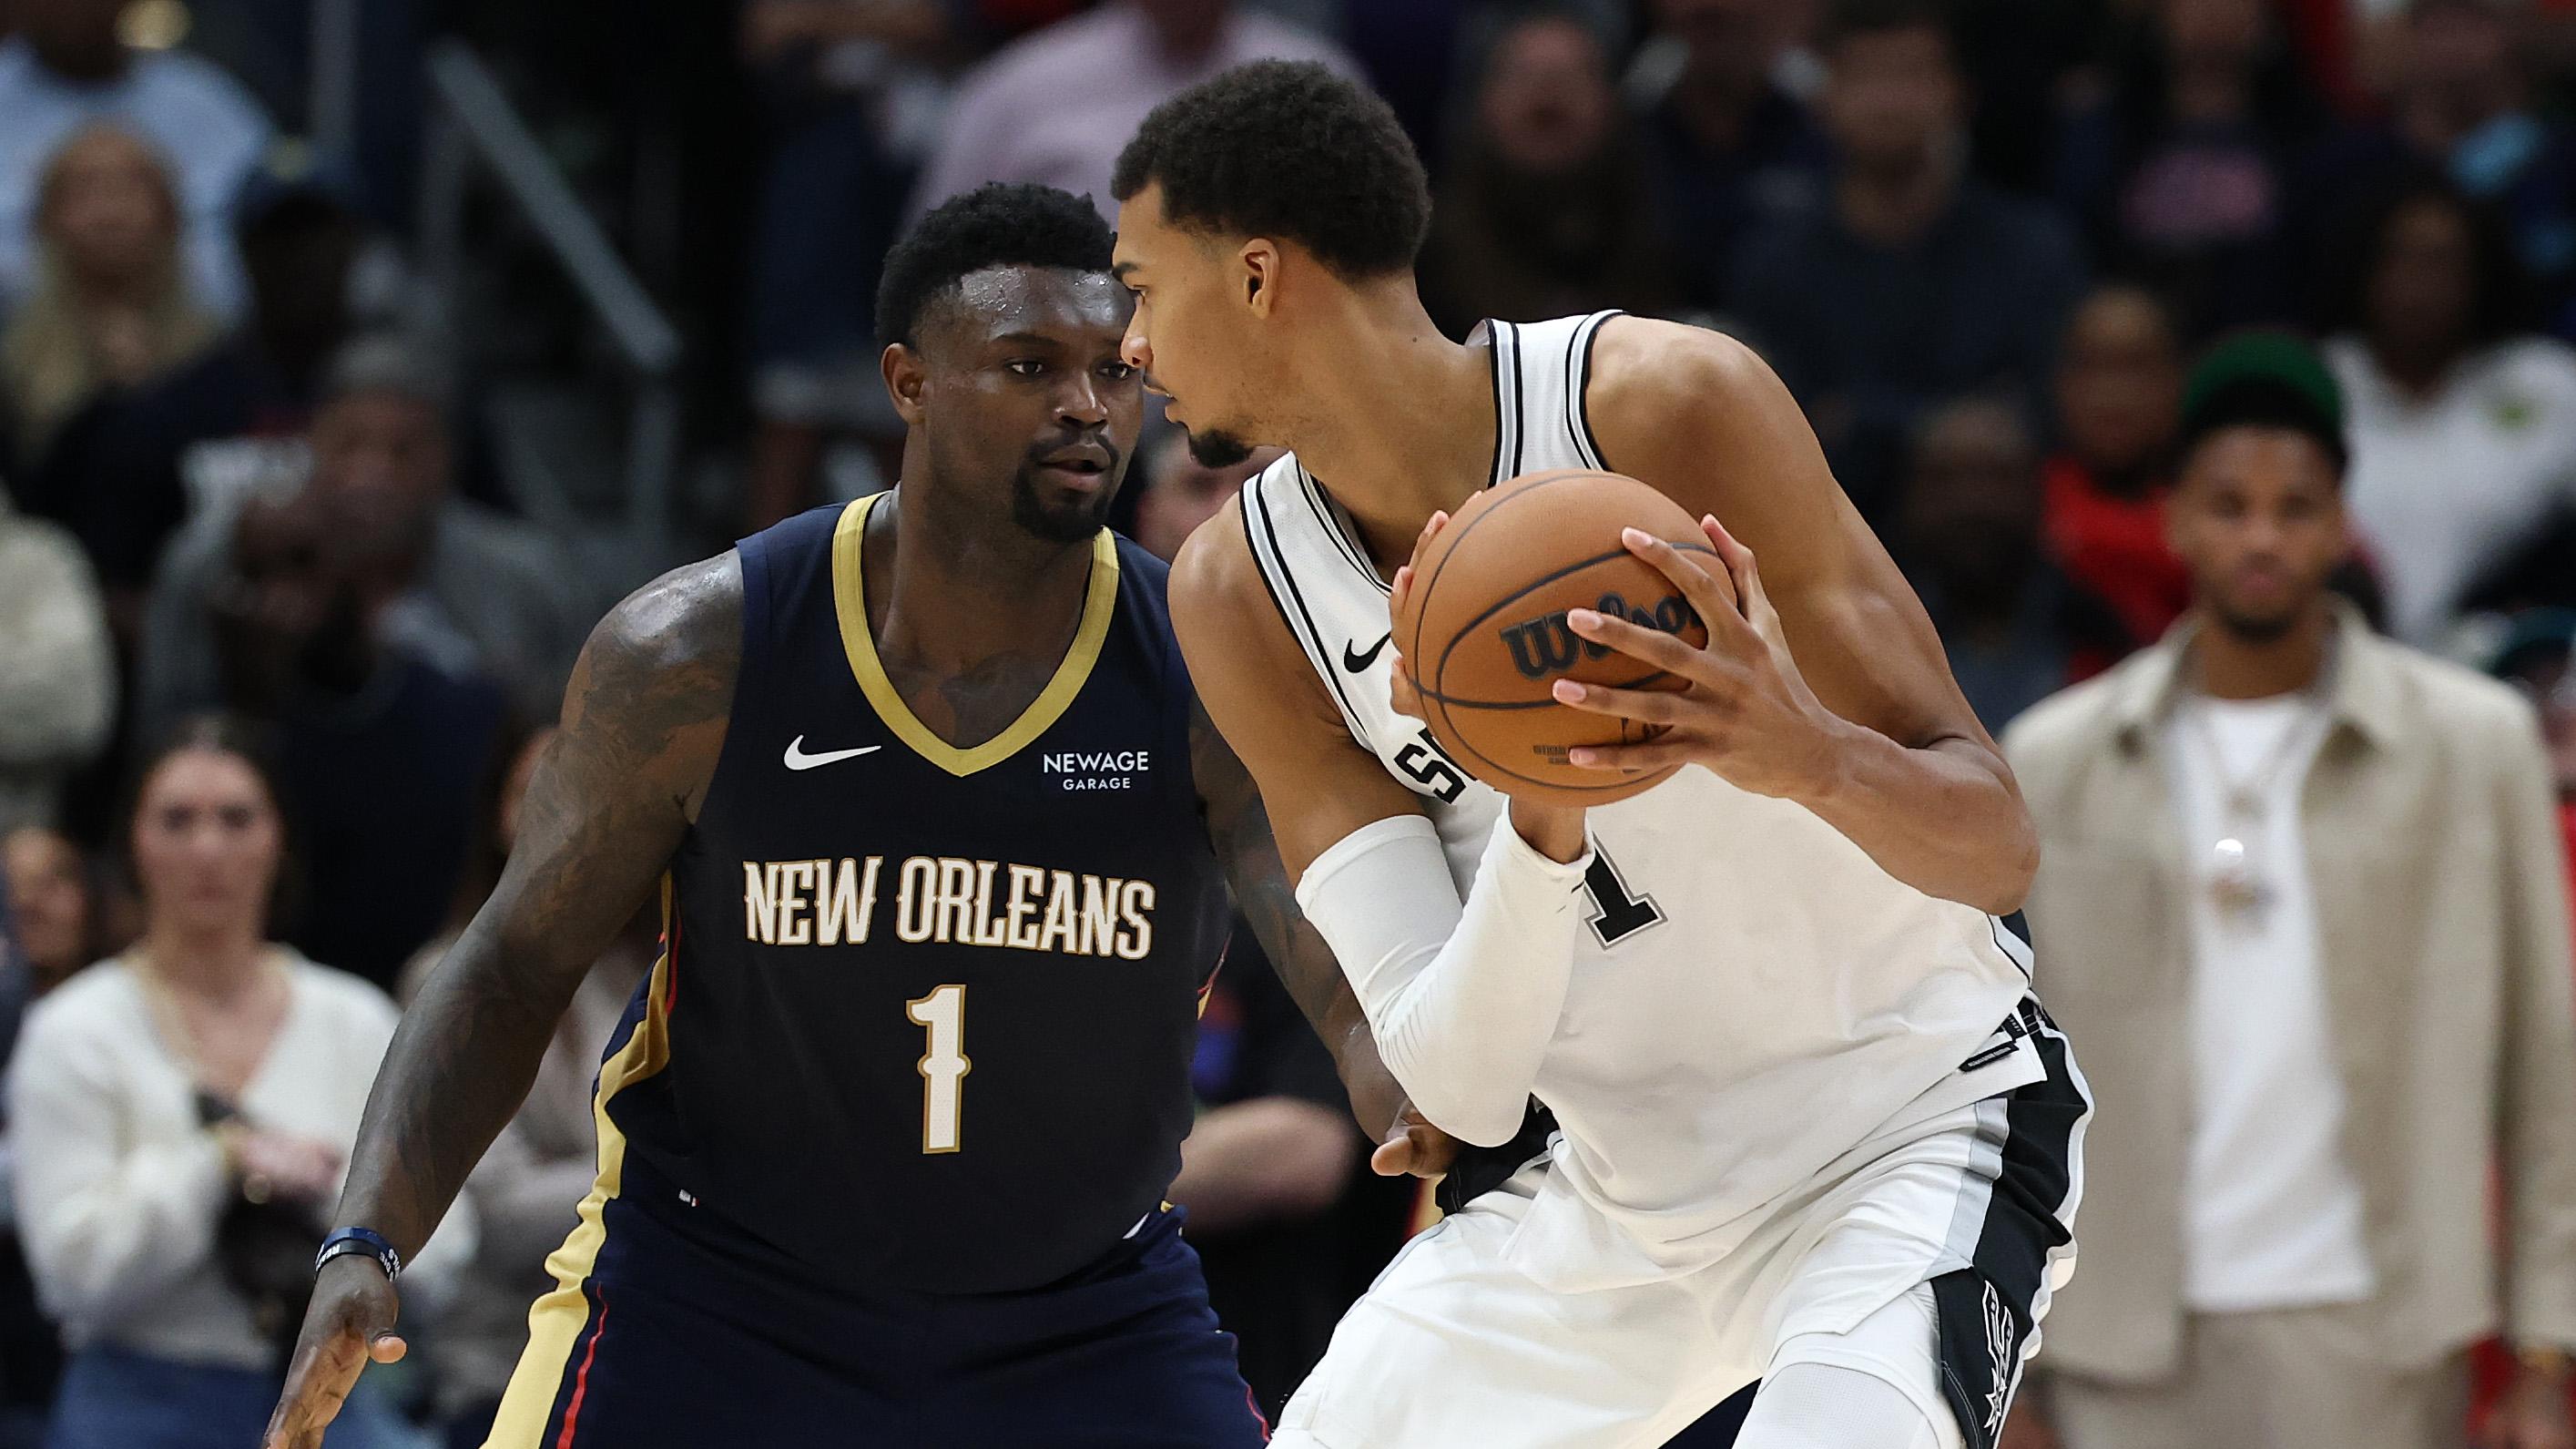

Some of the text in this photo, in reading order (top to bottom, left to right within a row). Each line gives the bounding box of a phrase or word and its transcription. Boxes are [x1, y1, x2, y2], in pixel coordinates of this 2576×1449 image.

[1501, 592, 1705, 680] Wso
[1044, 751, 1148, 773] NEWAGE
[1063, 777, 1131, 791] GARAGE
[743, 856, 1156, 959] NEW ORLEANS
[906, 984, 972, 1154] 1
